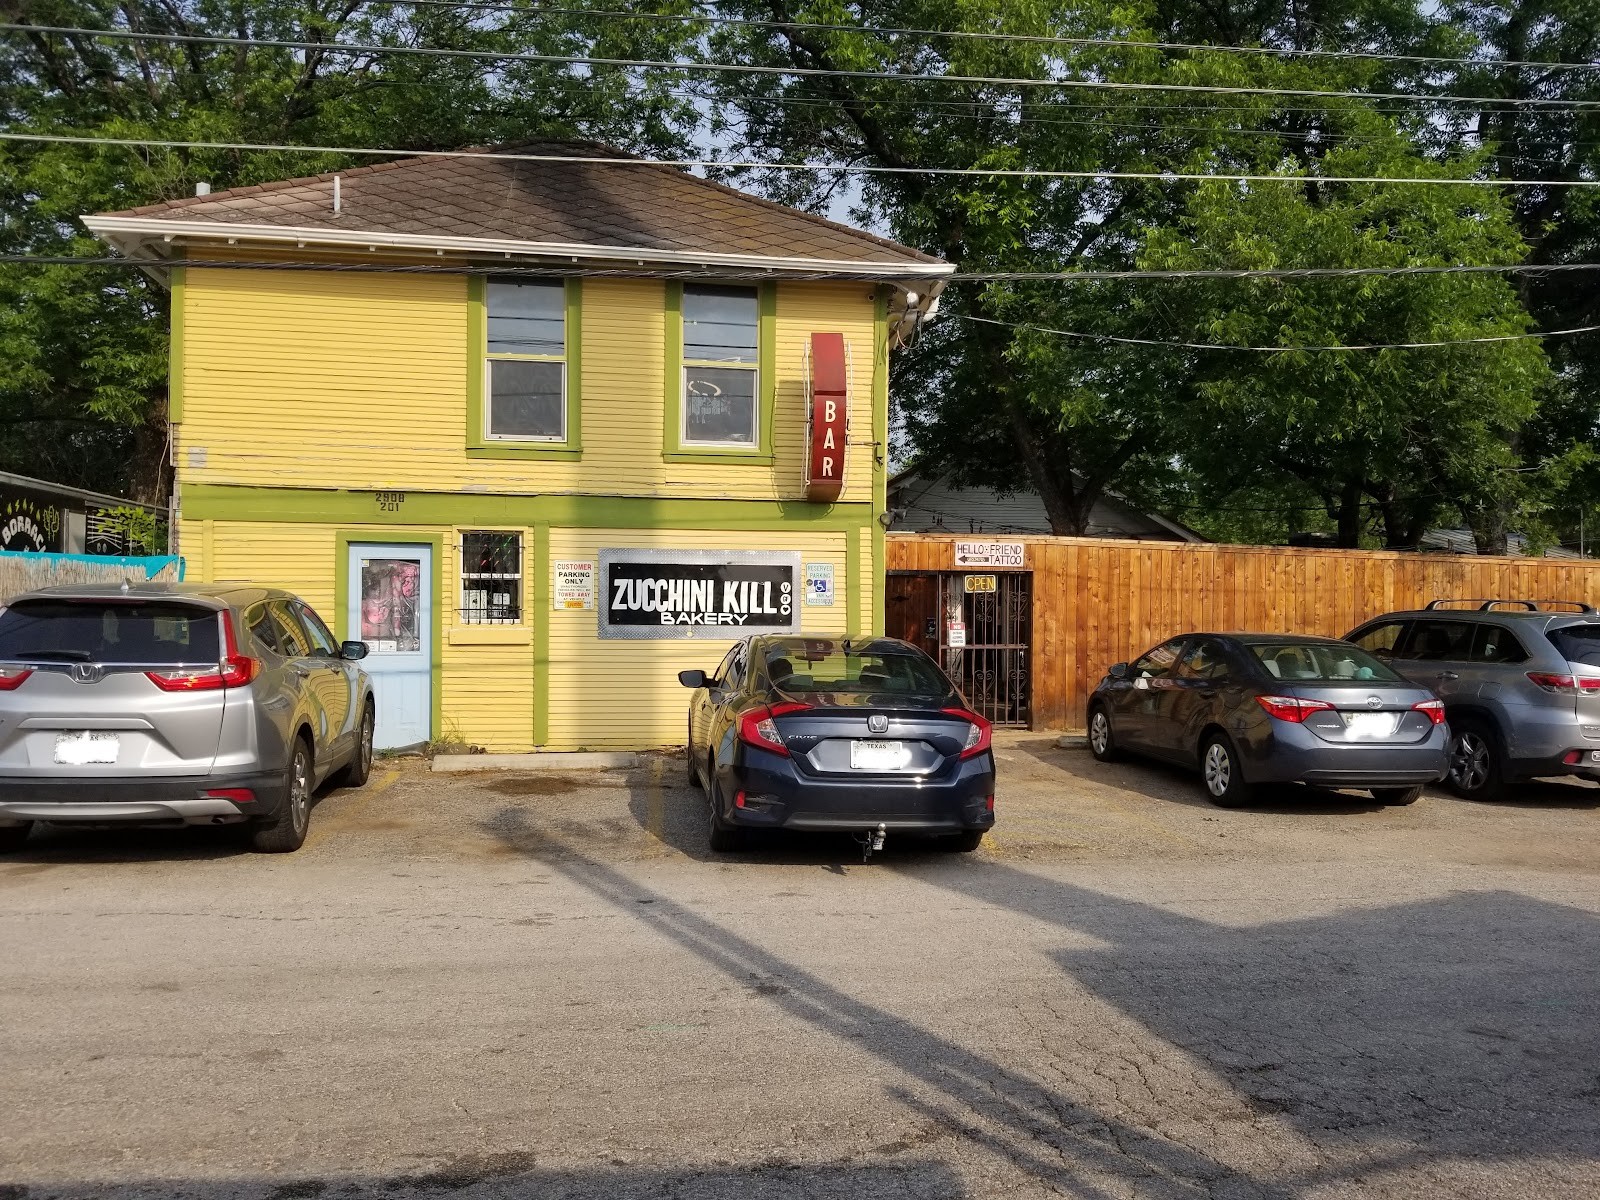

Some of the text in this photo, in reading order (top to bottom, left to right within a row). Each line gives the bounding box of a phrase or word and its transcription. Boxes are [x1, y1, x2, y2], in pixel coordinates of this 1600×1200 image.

[822, 400, 837, 477] BAR
[375, 493, 405, 502] 2908
[380, 502, 399, 512] 201
[957, 544, 1022, 555] HELLO FRIEND
[989, 554, 1022, 565] TATTOO
[966, 577, 994, 590] OPEN
[611, 578, 778, 614] ZUCCHINI KILL
[660, 612, 748, 625] BAKERY
